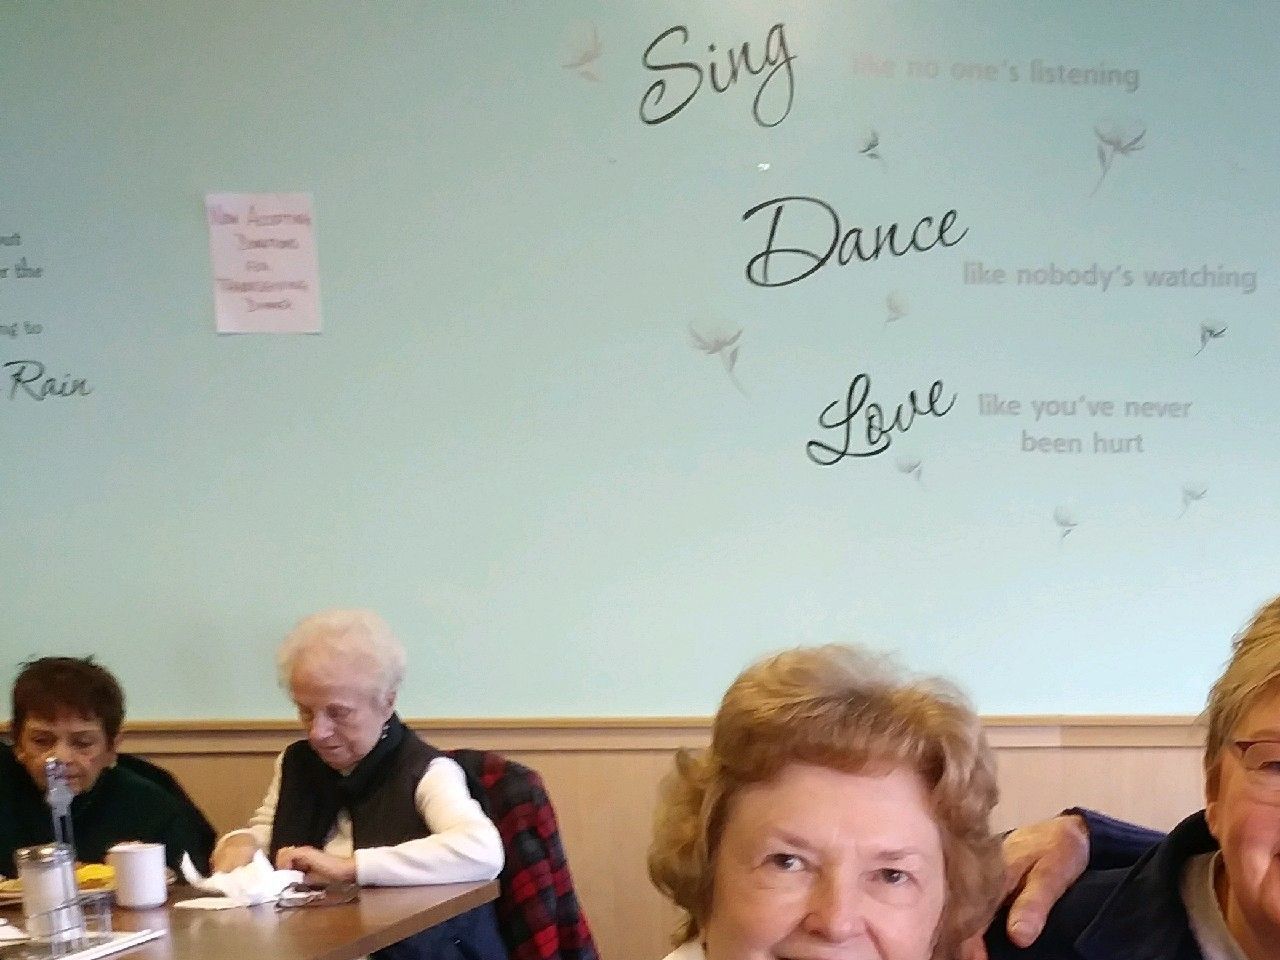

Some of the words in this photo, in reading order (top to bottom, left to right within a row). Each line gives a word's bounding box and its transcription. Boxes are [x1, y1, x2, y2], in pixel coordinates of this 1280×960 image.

[639, 22, 797, 127] Sing
[851, 51, 895, 79] like
[906, 59, 938, 79] no
[950, 58, 1020, 82] one's
[1030, 58, 1140, 92] listening
[743, 196, 969, 287] Dance
[963, 262, 1007, 286] like
[1016, 262, 1134, 294] nobody's
[1143, 264, 1258, 295] watching
[3, 359, 93, 401] Rain
[806, 373, 958, 465] Love
[978, 393, 1021, 416] like
[1032, 396, 1115, 421] you've
[1124, 398, 1193, 419] never
[1021, 430, 1083, 453] been
[1093, 431, 1144, 454] hurt
